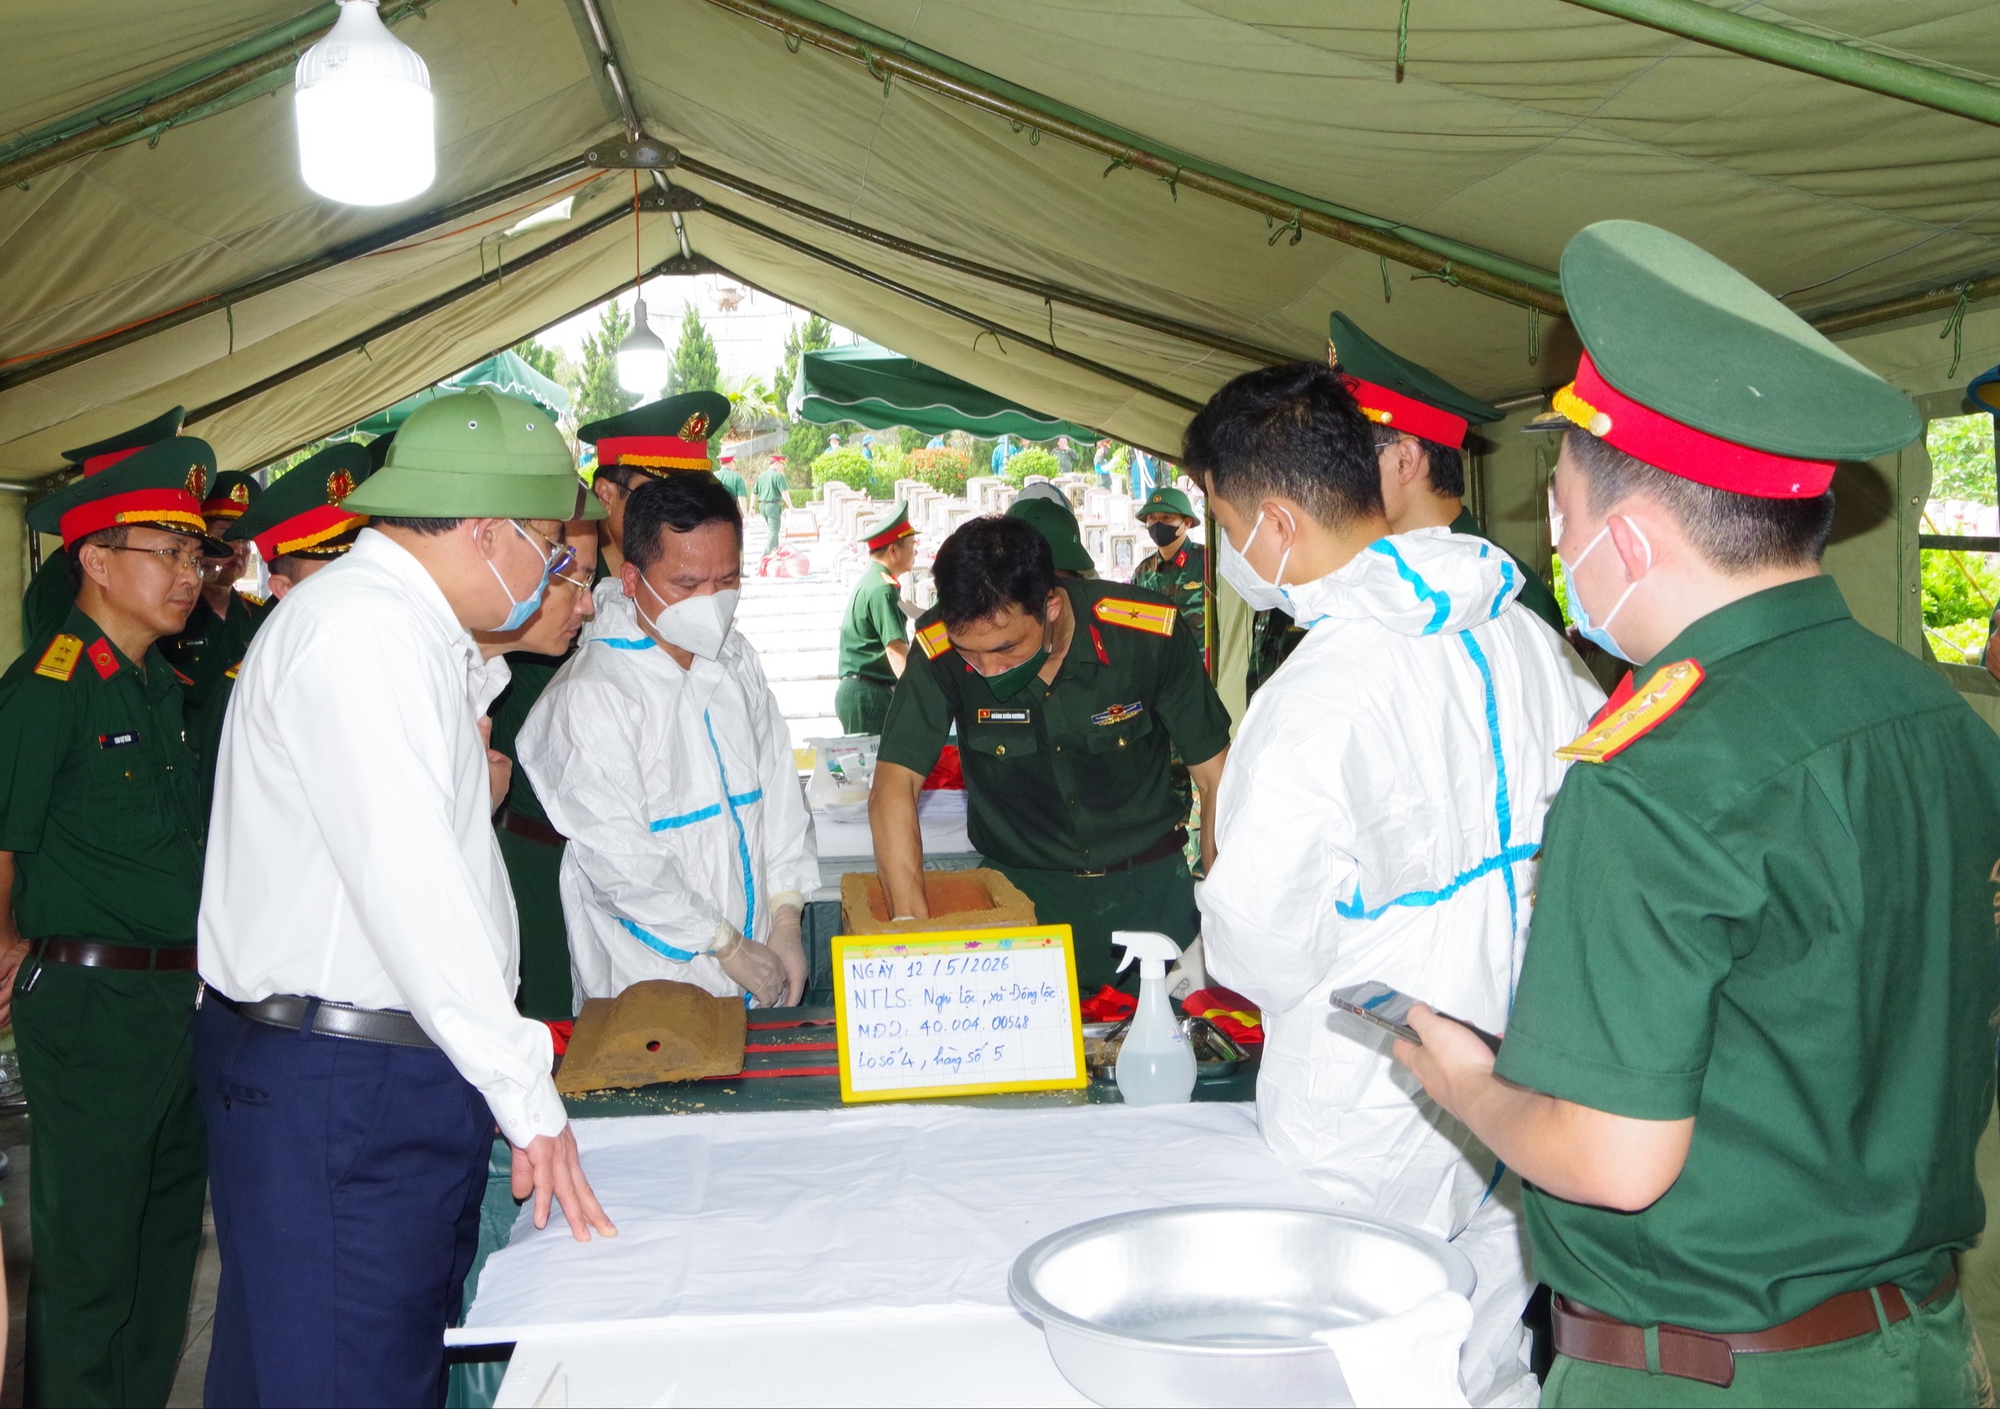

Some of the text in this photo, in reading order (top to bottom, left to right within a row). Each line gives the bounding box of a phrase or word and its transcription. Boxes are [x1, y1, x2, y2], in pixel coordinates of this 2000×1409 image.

[852, 959, 894, 980] NGÀY
[854, 987, 912, 1010] NTLS:
[993, 1044, 1006, 1061] 5
